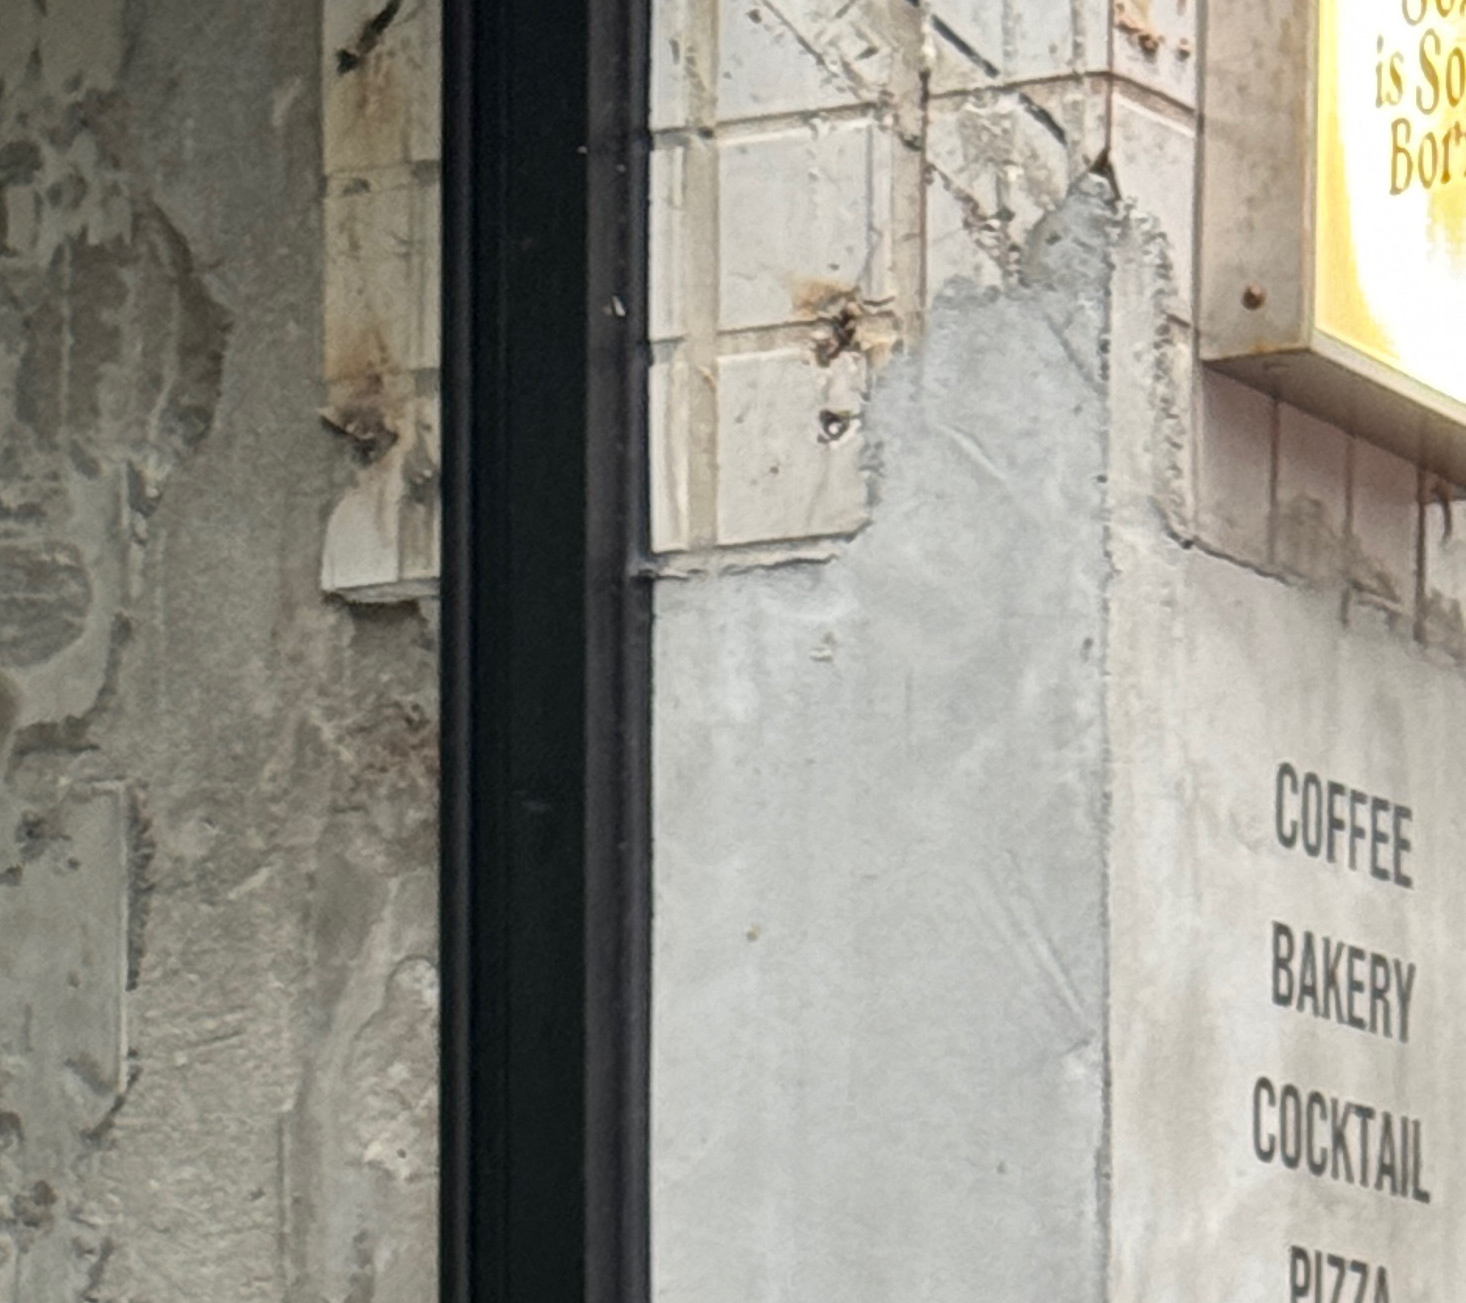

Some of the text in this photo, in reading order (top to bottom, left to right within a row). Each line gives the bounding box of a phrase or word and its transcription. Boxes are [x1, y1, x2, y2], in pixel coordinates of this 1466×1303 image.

[1375, 34, 1404, 109] is
[1390, 117, 1466, 196] Bor
[1275, 762, 1414, 889] COFFEE
[1272, 920, 1416, 1043] BAKERY
[1252, 1076, 1431, 1201] COCKTAIL
